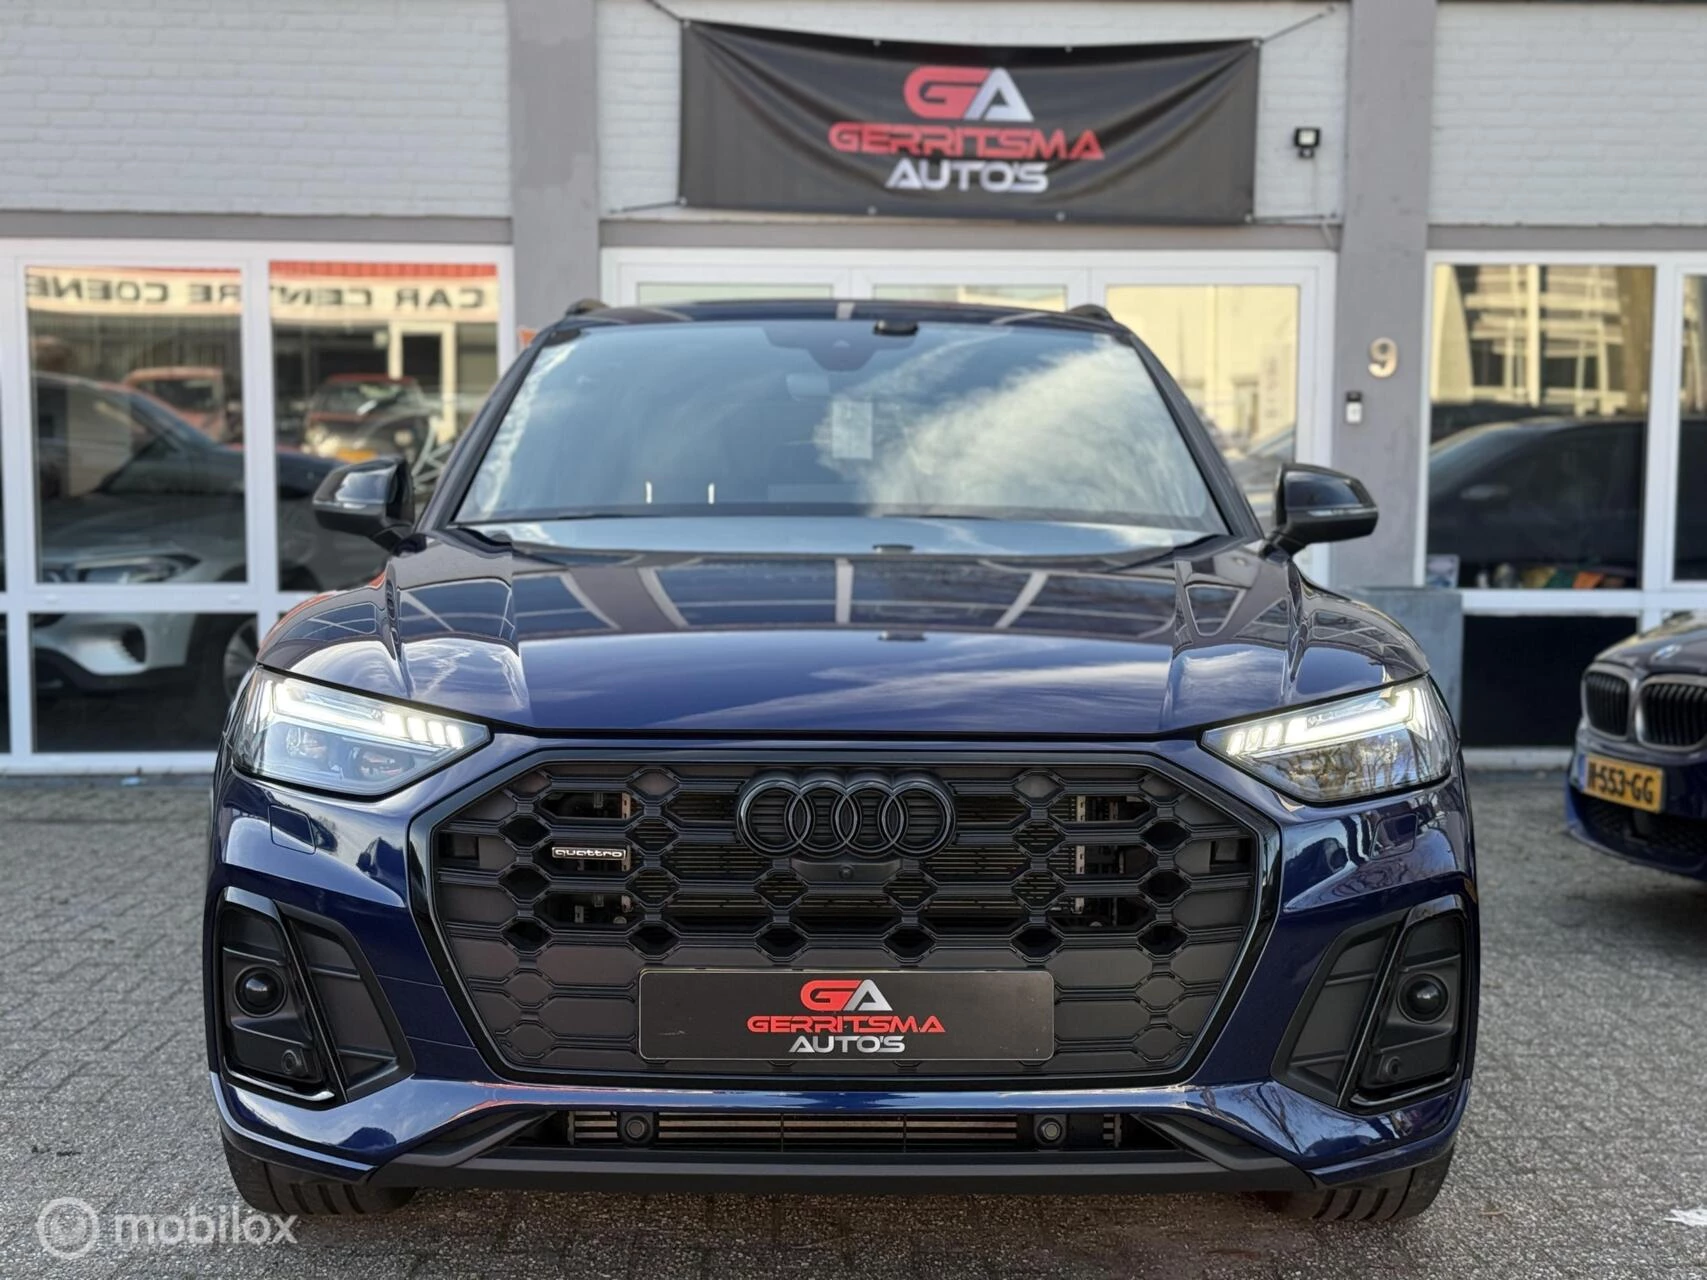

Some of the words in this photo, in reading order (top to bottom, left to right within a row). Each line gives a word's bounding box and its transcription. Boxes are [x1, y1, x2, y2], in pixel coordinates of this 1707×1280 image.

[828, 122, 1105, 161] GERRITSMA
[886, 159, 1049, 194] AUTO'S
[1368, 337, 1398, 378] 9
[554, 848, 623, 859] quattro
[800, 979, 893, 1011] GA
[747, 1016, 946, 1033] GERRITSMA
[788, 1035, 905, 1053] AUTO'S
